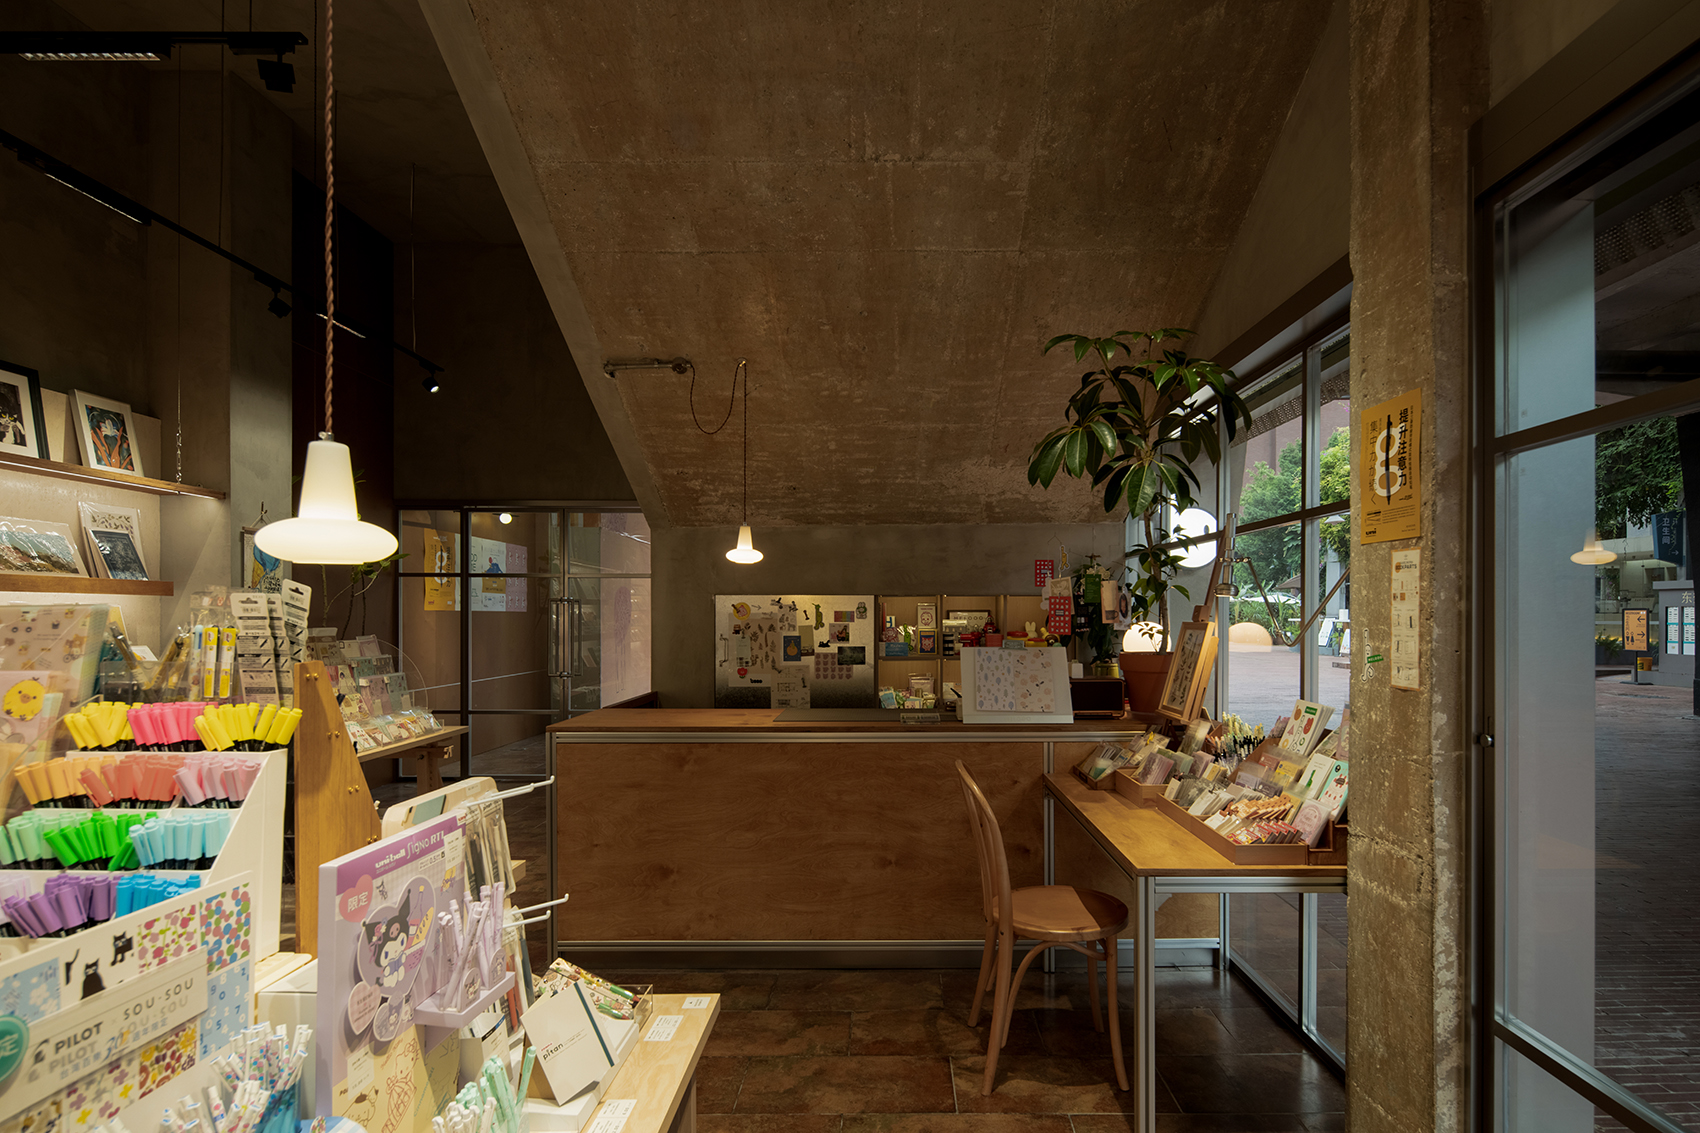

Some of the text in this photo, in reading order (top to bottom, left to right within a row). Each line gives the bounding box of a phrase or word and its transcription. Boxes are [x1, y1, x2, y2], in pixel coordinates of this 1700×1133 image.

[1397, 407, 1409, 487] 提升注意力
[1661, 517, 1671, 544] 卫生间
[1682, 591, 1695, 604] 东
[347, 891, 368, 913] 限定
[54, 1021, 104, 1055] PILOT
[542, 1043, 564, 1061] pitan
